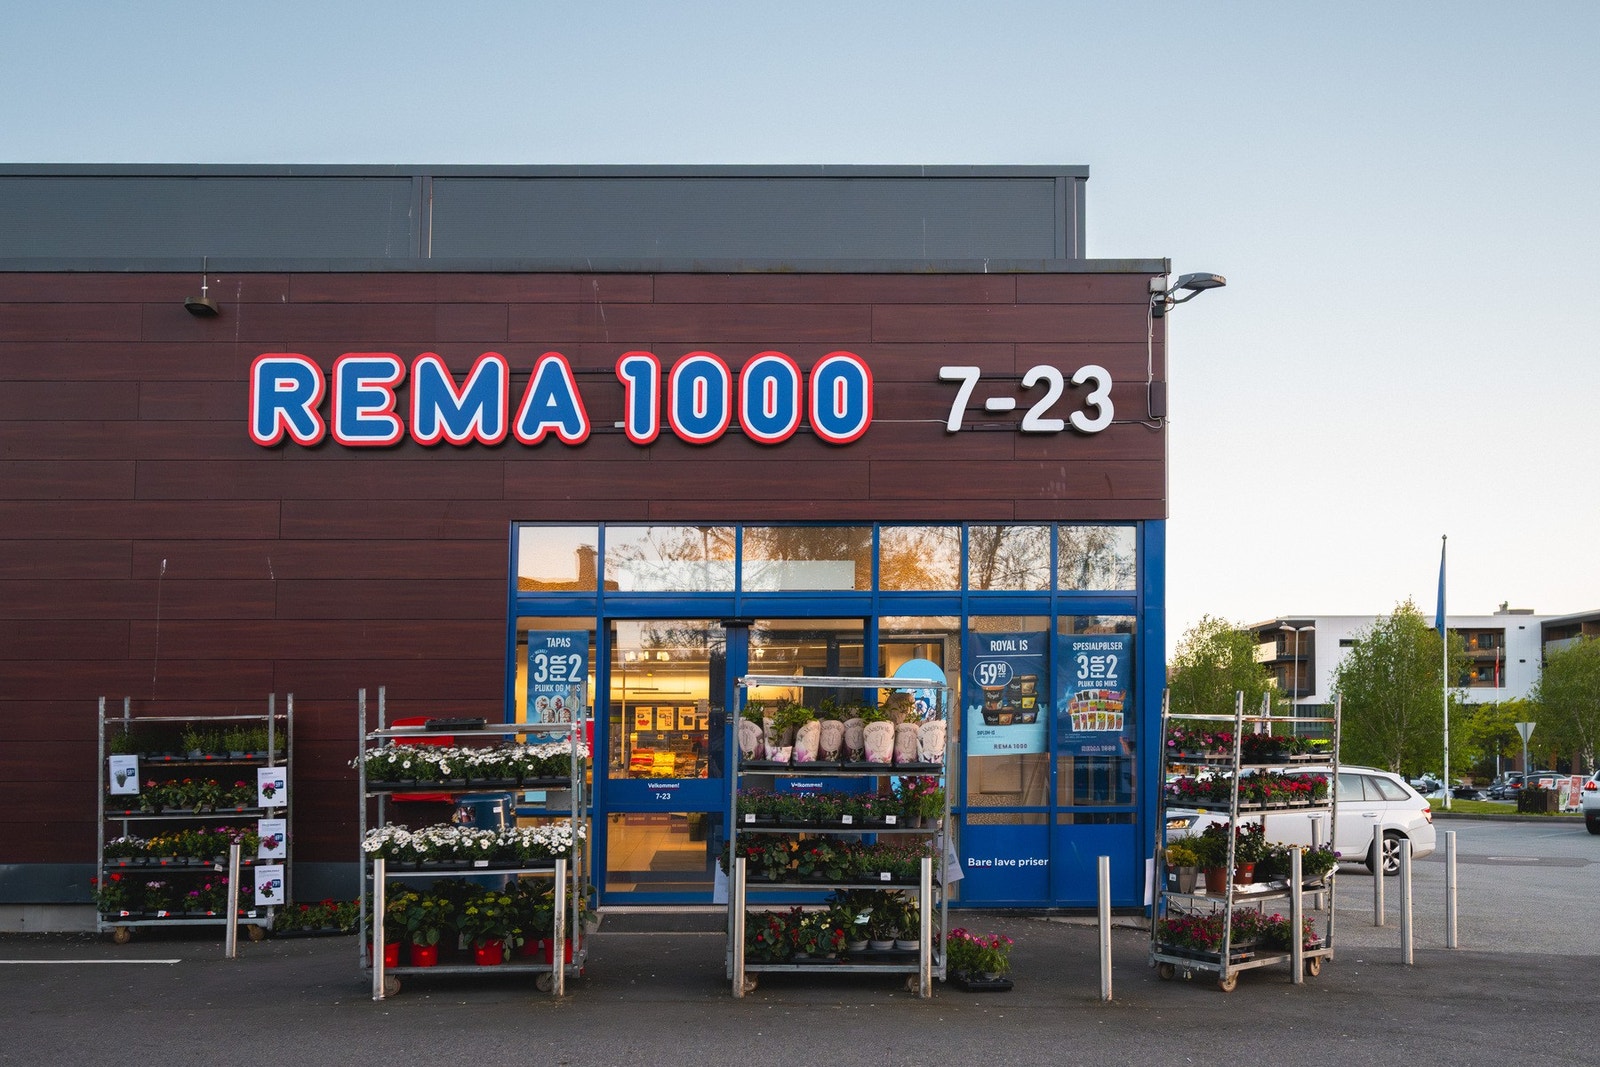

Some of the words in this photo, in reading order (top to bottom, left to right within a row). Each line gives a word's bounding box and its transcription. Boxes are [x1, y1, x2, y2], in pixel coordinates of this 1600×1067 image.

[248, 351, 591, 447] REMA
[615, 350, 874, 445] 1000
[938, 364, 1115, 434] 7-23
[546, 637, 571, 648] TAPAS
[990, 640, 1016, 652] ROYAL
[1019, 639, 1028, 651] IS
[1072, 641, 1123, 651] SPESIALPØLSER
[534, 653, 548, 683] 3
[550, 655, 567, 681] FOR
[568, 653, 582, 682] 2
[1077, 655, 1089, 679] 3
[1090, 655, 1105, 679] FOR
[1106, 654, 1118, 679] 2
[980, 664, 998, 685] 59
[998, 663, 1007, 673] 90
[535, 684, 554, 692] PLUKK
[555, 684, 564, 692] OG
[655, 792, 671, 800] 7-23
[967, 857, 992, 867] Bare
[994, 857, 1016, 866] lave
[1018, 856, 1049, 867] priser
